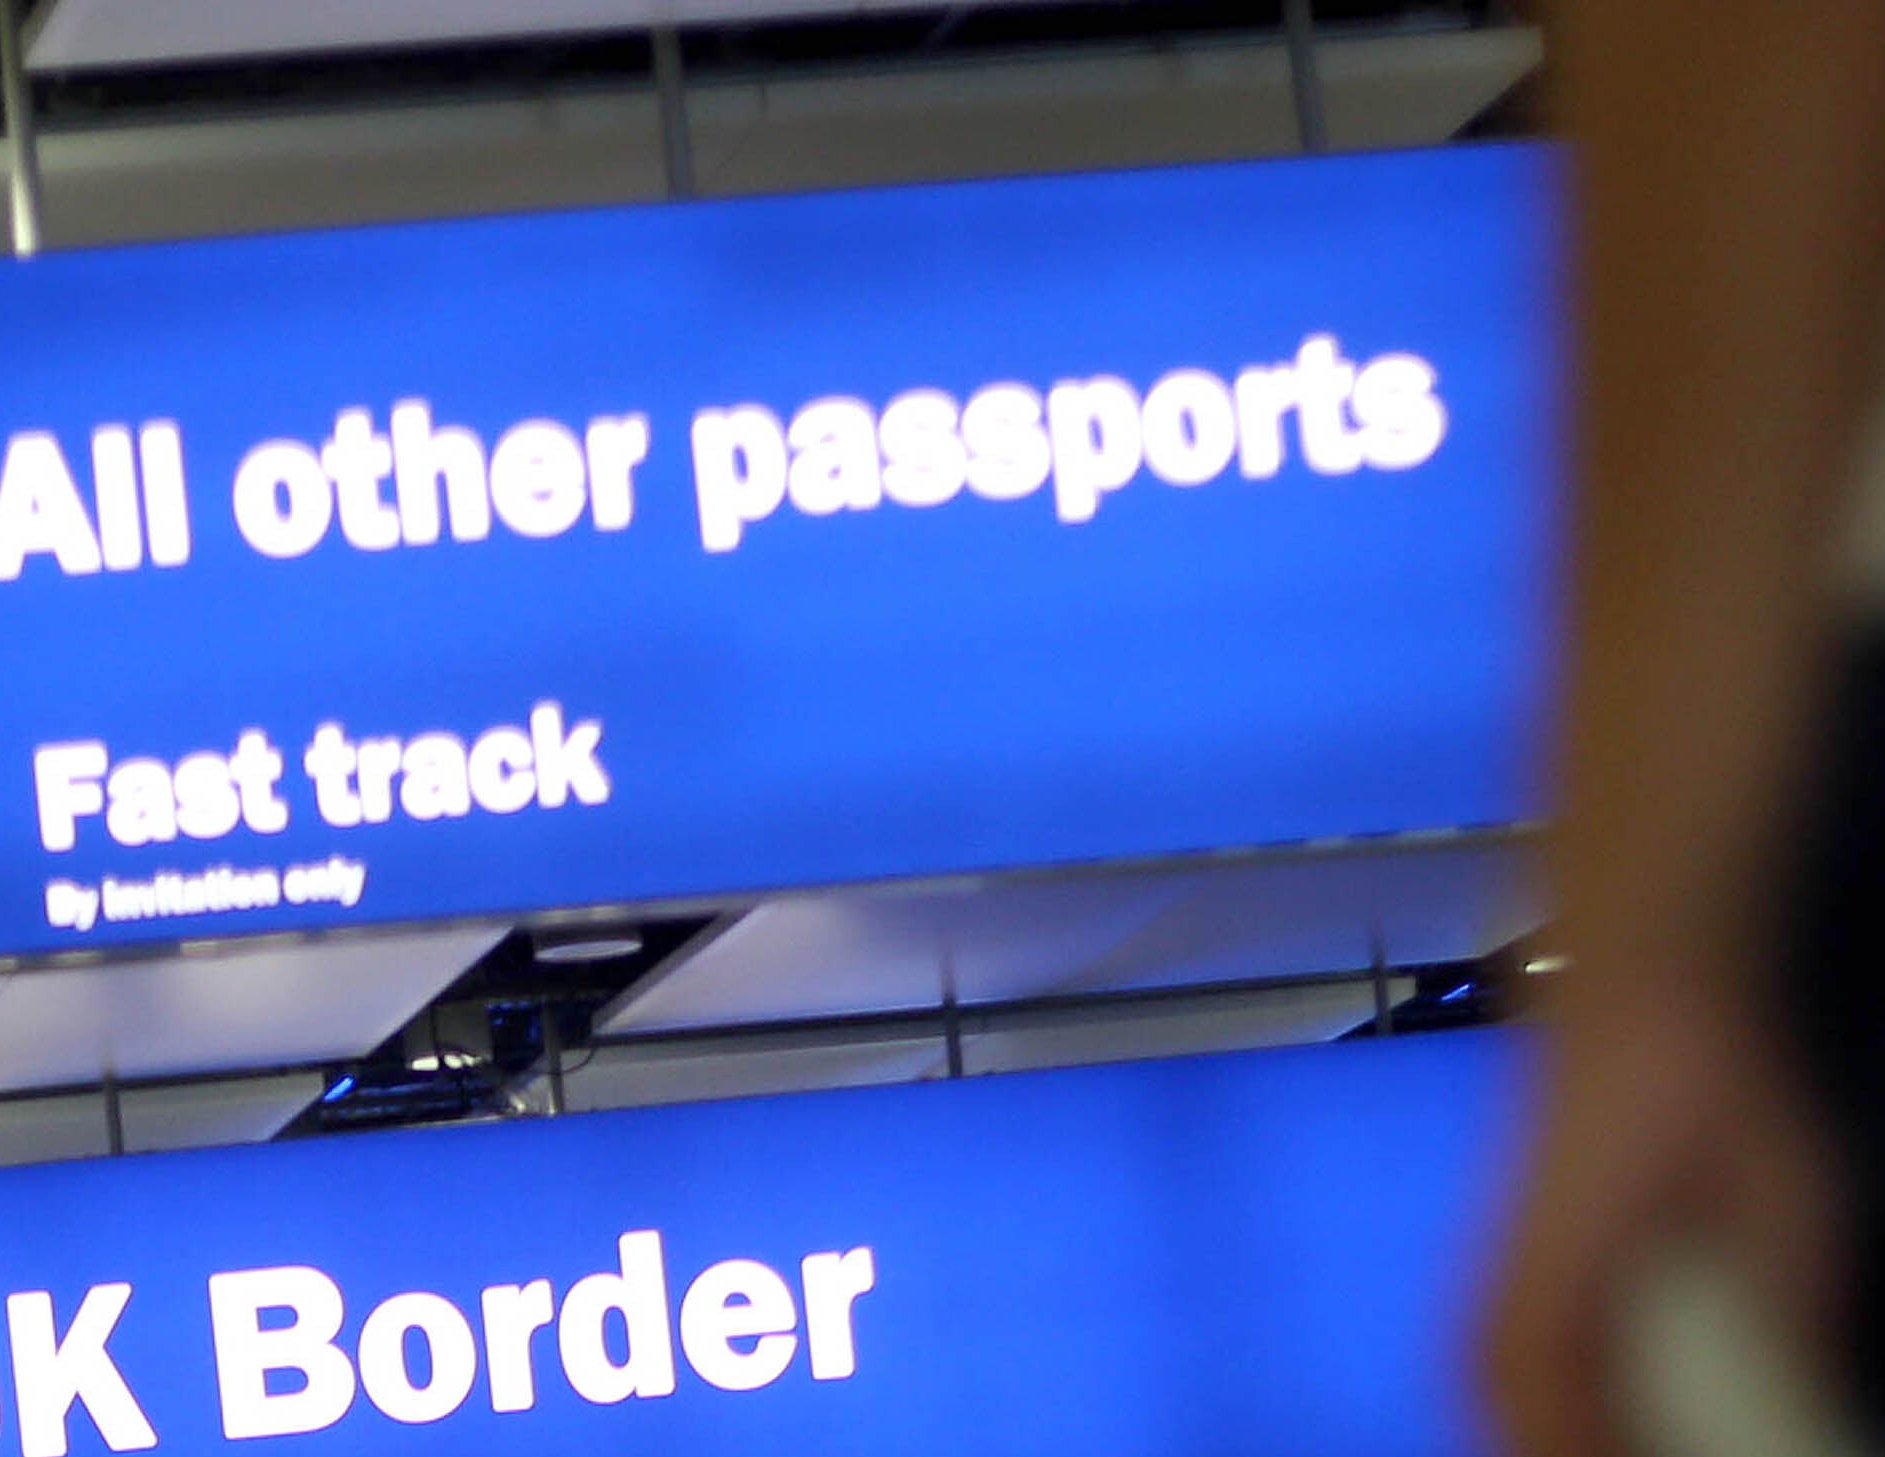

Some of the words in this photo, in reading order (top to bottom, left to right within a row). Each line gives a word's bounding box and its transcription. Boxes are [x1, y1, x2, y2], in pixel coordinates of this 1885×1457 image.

[232, 396, 651, 560] other
[690, 332, 1448, 554] passports
[33, 727, 289, 853] Fast
[303, 700, 611, 828] track
[44, 878, 100, 931] By
[281, 855, 366, 907] only
[208, 1228, 876, 1441] Border
